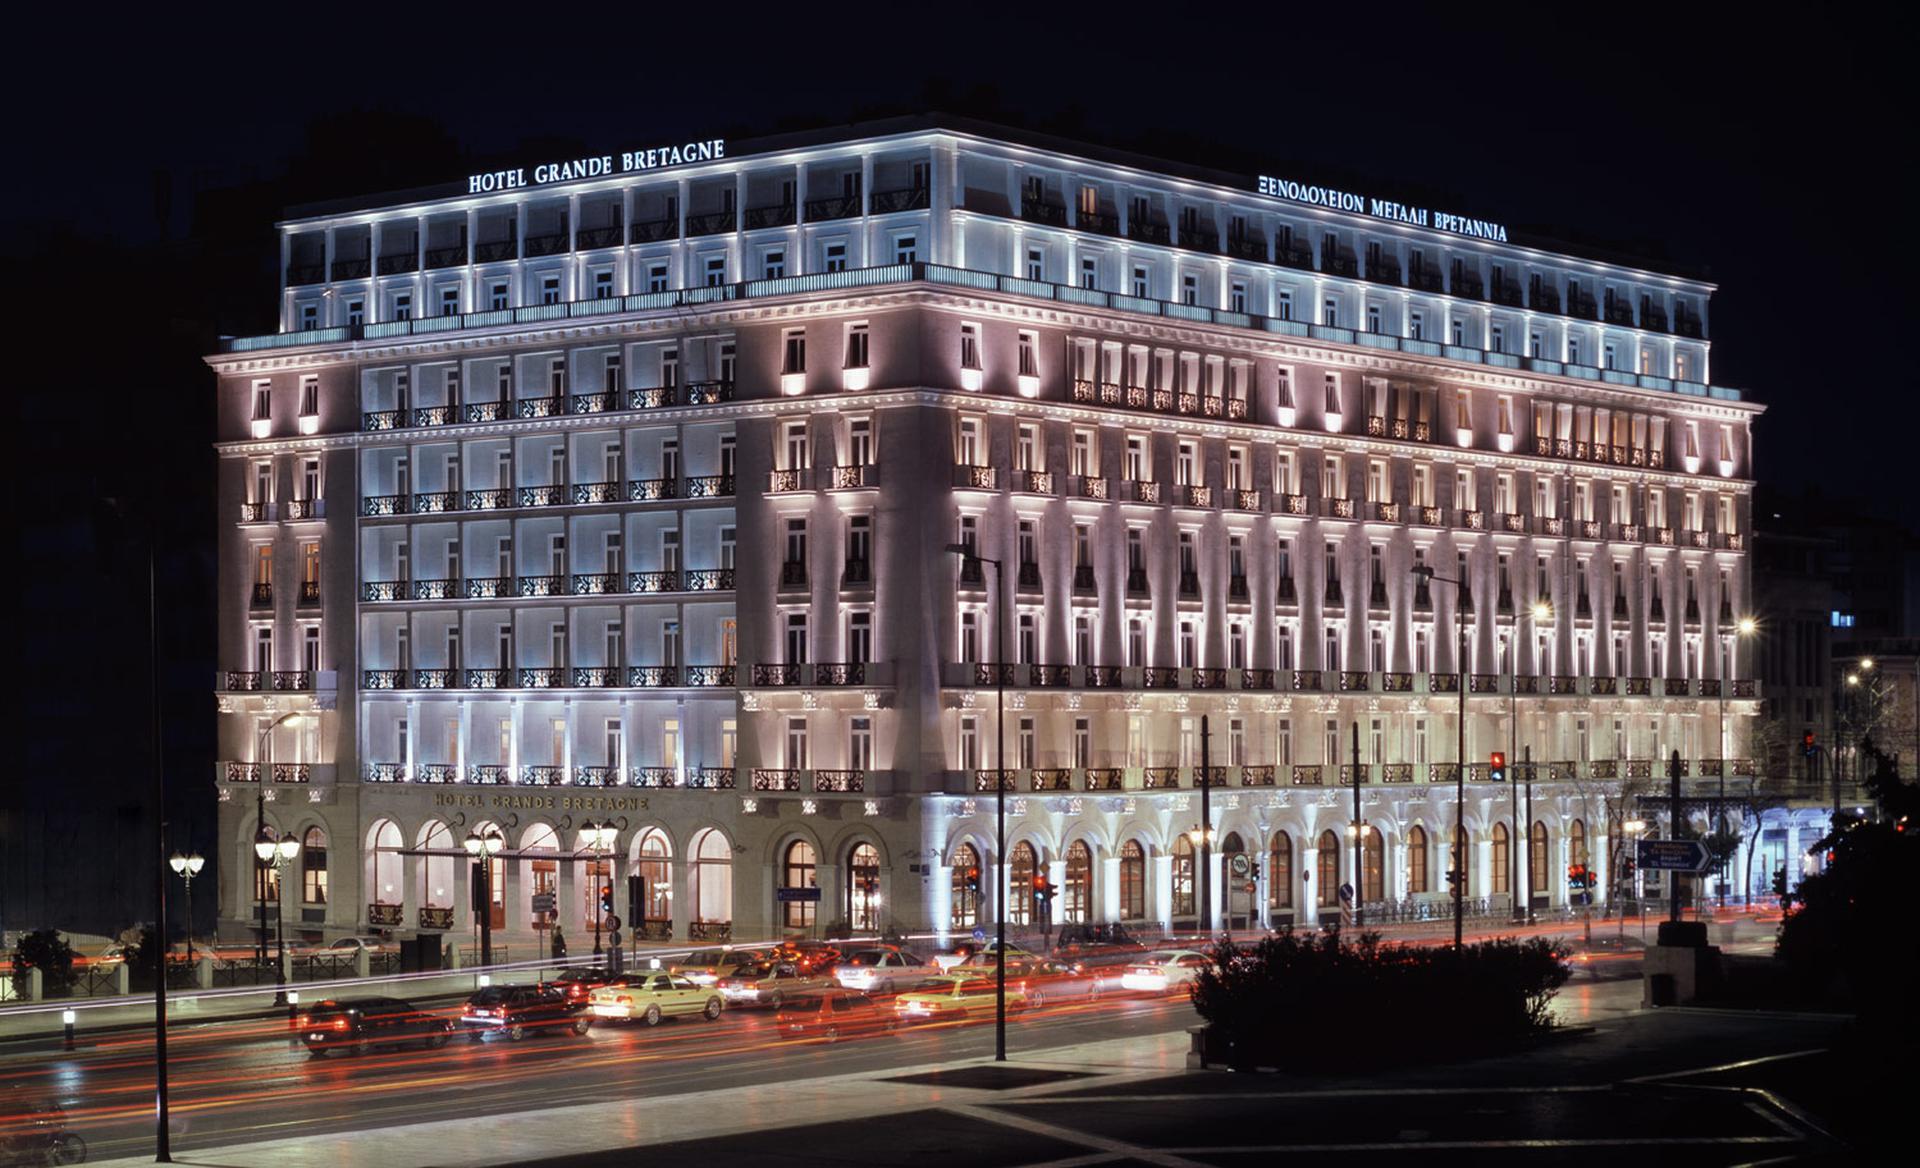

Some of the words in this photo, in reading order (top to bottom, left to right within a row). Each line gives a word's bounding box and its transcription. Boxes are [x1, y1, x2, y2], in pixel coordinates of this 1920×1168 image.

[469, 168, 527, 193] HOTEL
[534, 156, 612, 184] GRANDE
[622, 139, 725, 171] BRETAGNE
[1258, 175, 1364, 213] ΞΕΝΟΔΟΧΕΙΟΝ
[1371, 198, 1428, 226] ΜΕΓΑΛΗ
[1434, 211, 1508, 242] ΒΡΕΤΑΝΝΙΑ
[433, 793, 484, 807] HOTEL
[492, 796, 555, 809] GRANDE
[562, 797, 649, 811] BRETAGNE
